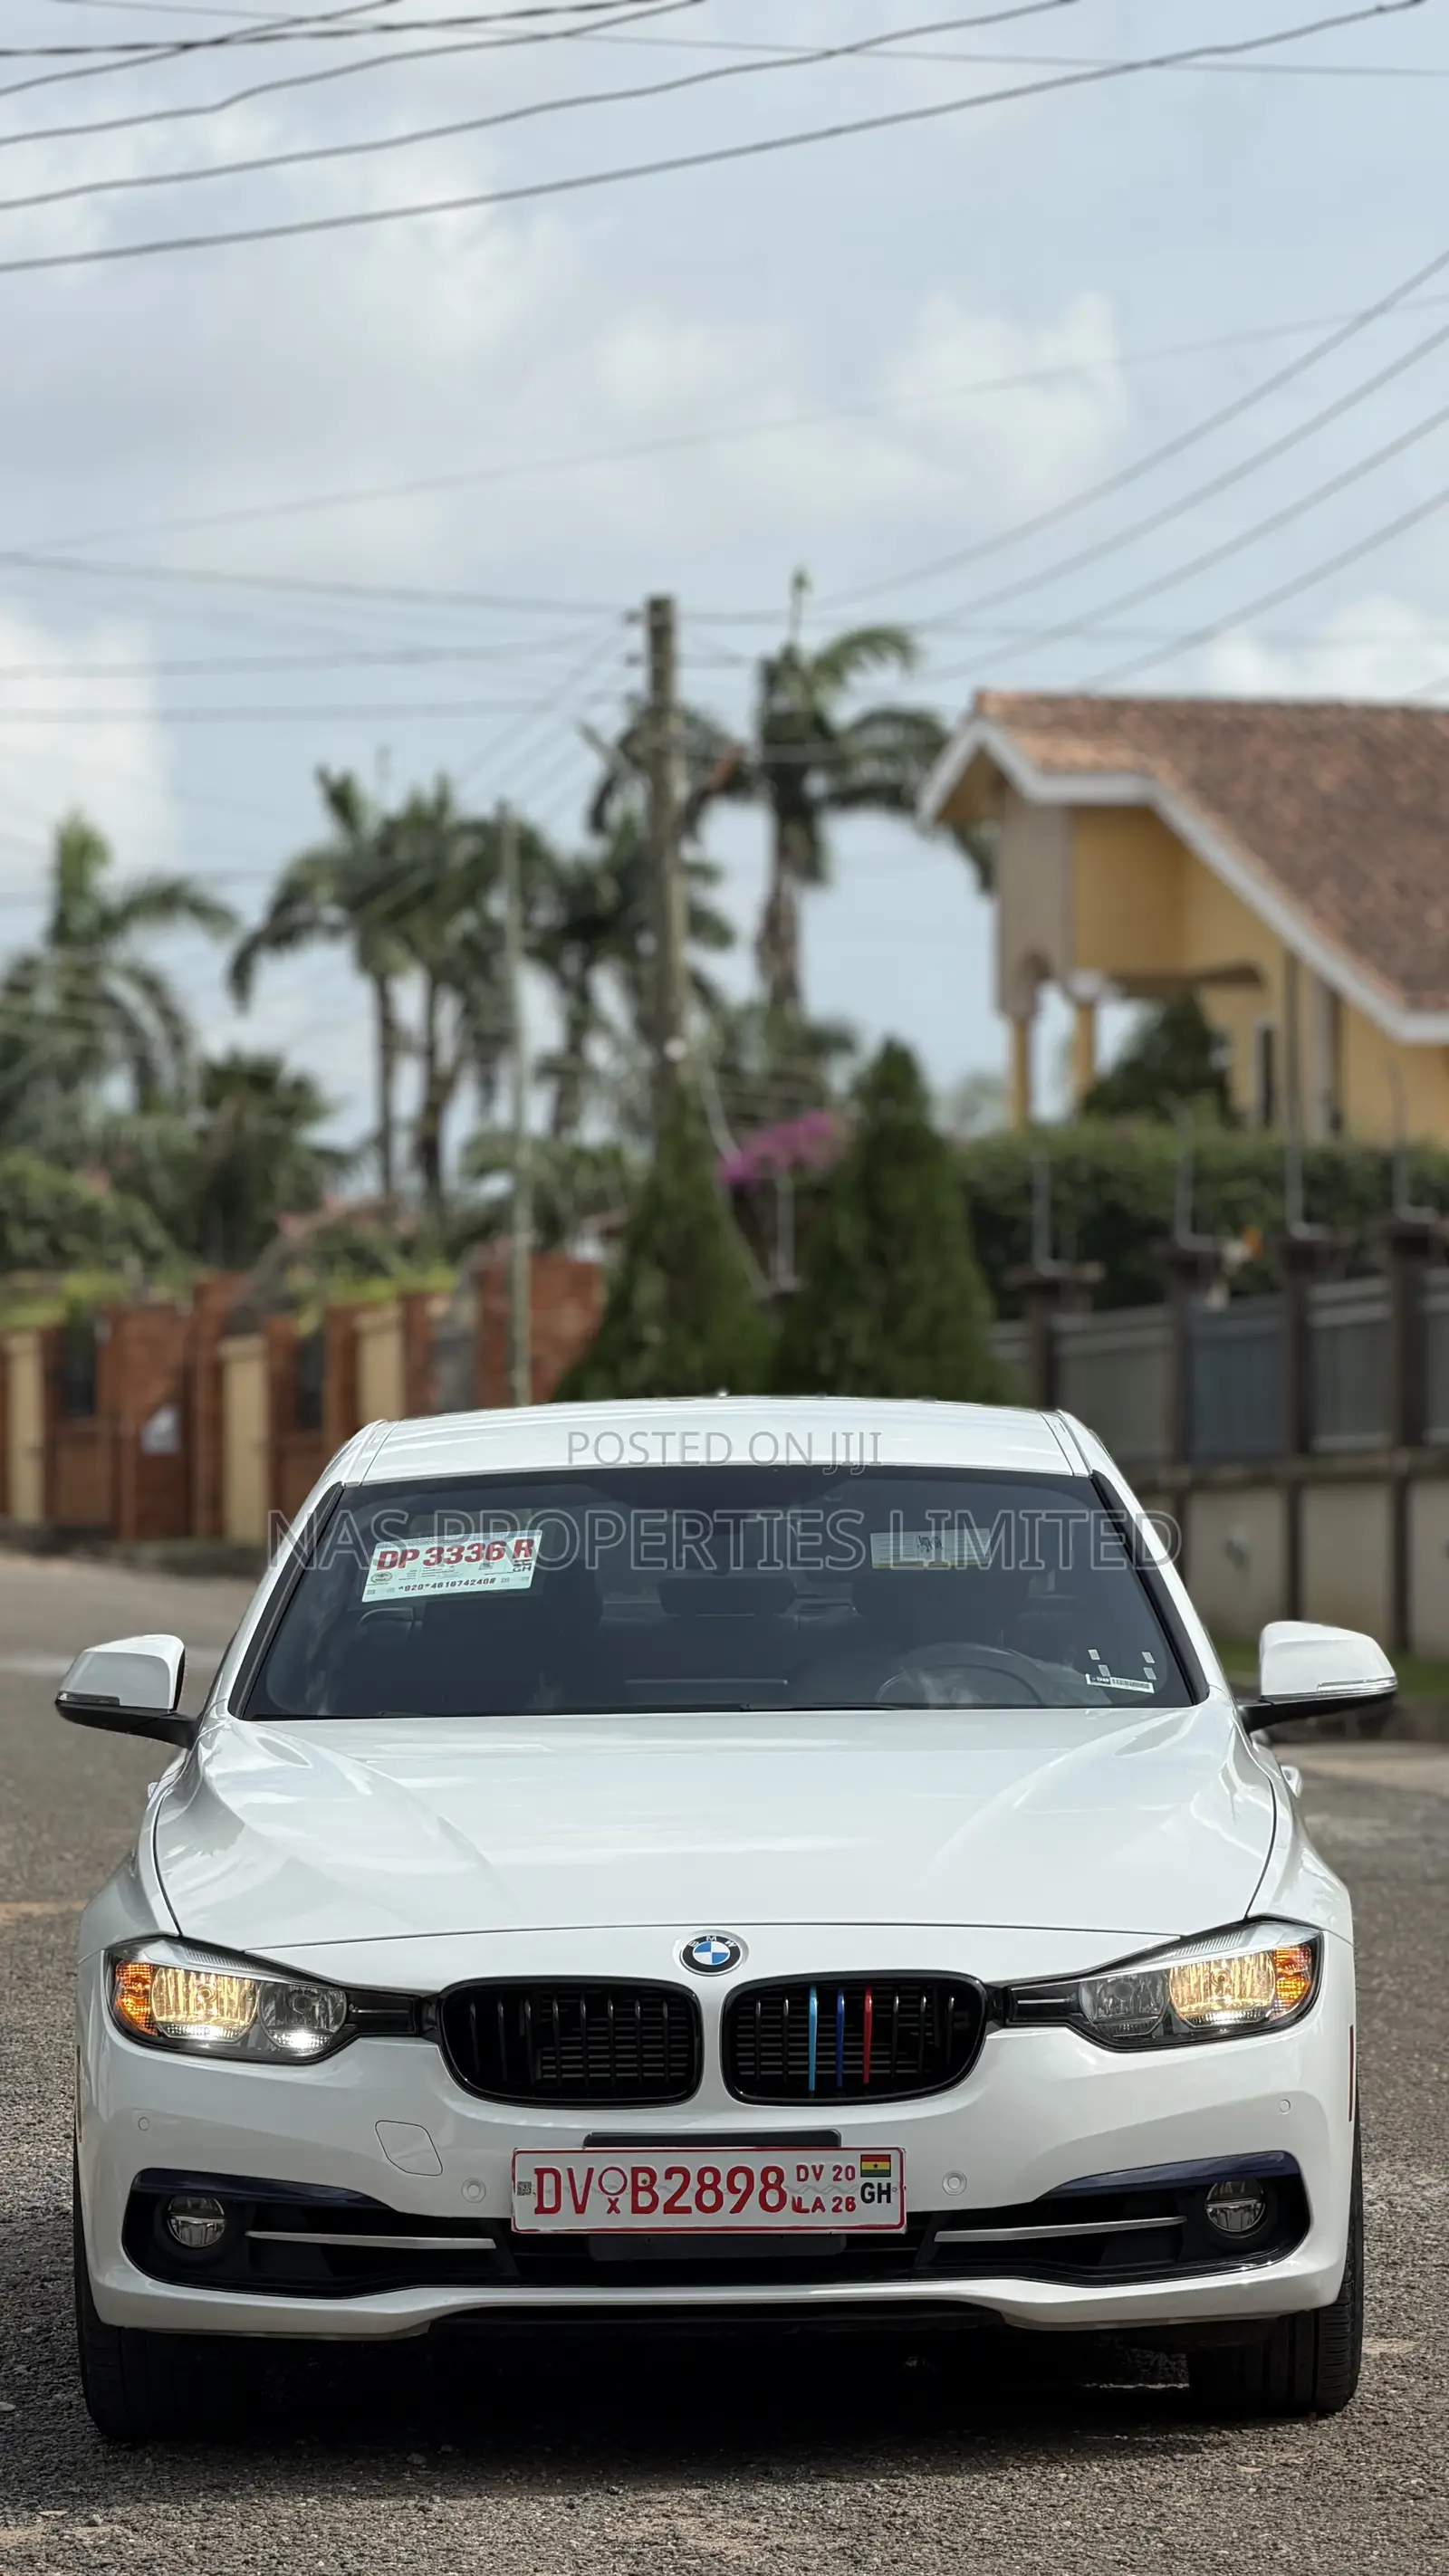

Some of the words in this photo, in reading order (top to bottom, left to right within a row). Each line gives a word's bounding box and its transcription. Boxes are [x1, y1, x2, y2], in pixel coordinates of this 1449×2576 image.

[376, 1548, 420, 1571] DP
[422, 1540, 506, 1567] 3336
[511, 1538, 535, 1559] R
[688, 1935, 737, 1948] BMW
[796, 2164, 824, 2182] DV
[832, 2165, 856, 2181] 20
[860, 2182, 891, 2204] GH
[831, 2196, 857, 2213] 26
